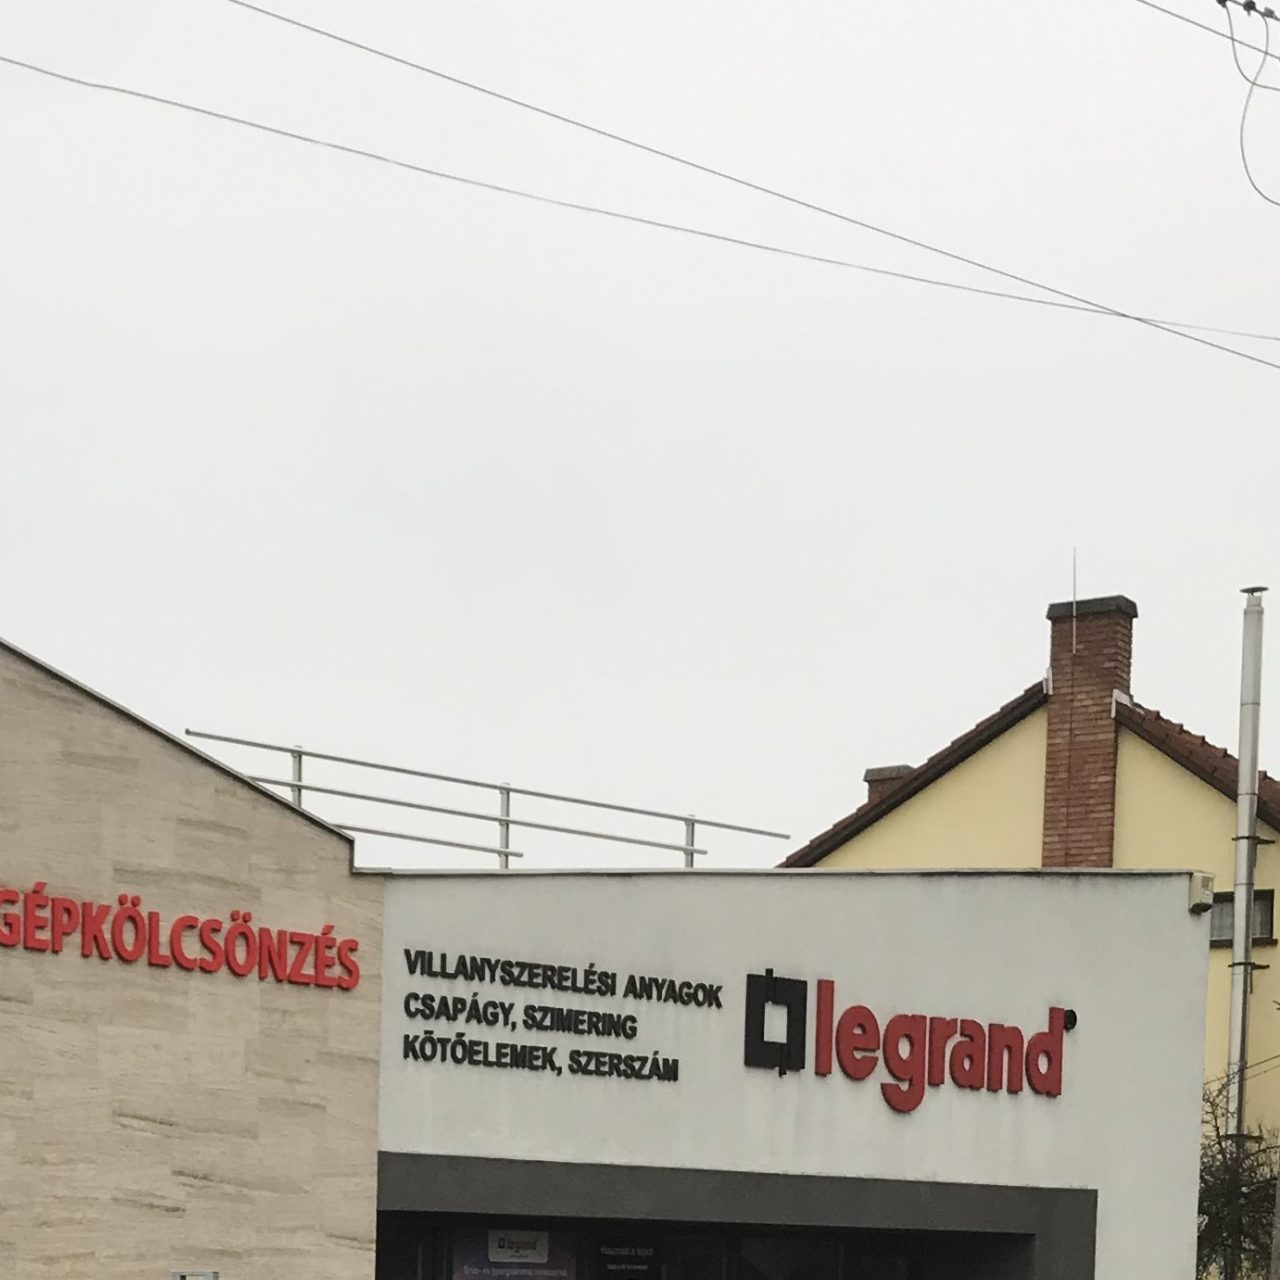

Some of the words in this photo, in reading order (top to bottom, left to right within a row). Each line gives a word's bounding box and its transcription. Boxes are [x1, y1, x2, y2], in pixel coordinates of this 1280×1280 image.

[404, 948, 617, 997] VILLANYSZERELÉSI
[623, 974, 723, 1008] ANYAGOK
[404, 991, 518, 1031] CSAPÁGY,
[522, 1004, 638, 1040] SZIMERING
[568, 1050, 680, 1082] SZERSZÁM
[814, 978, 1065, 1113] legrand
